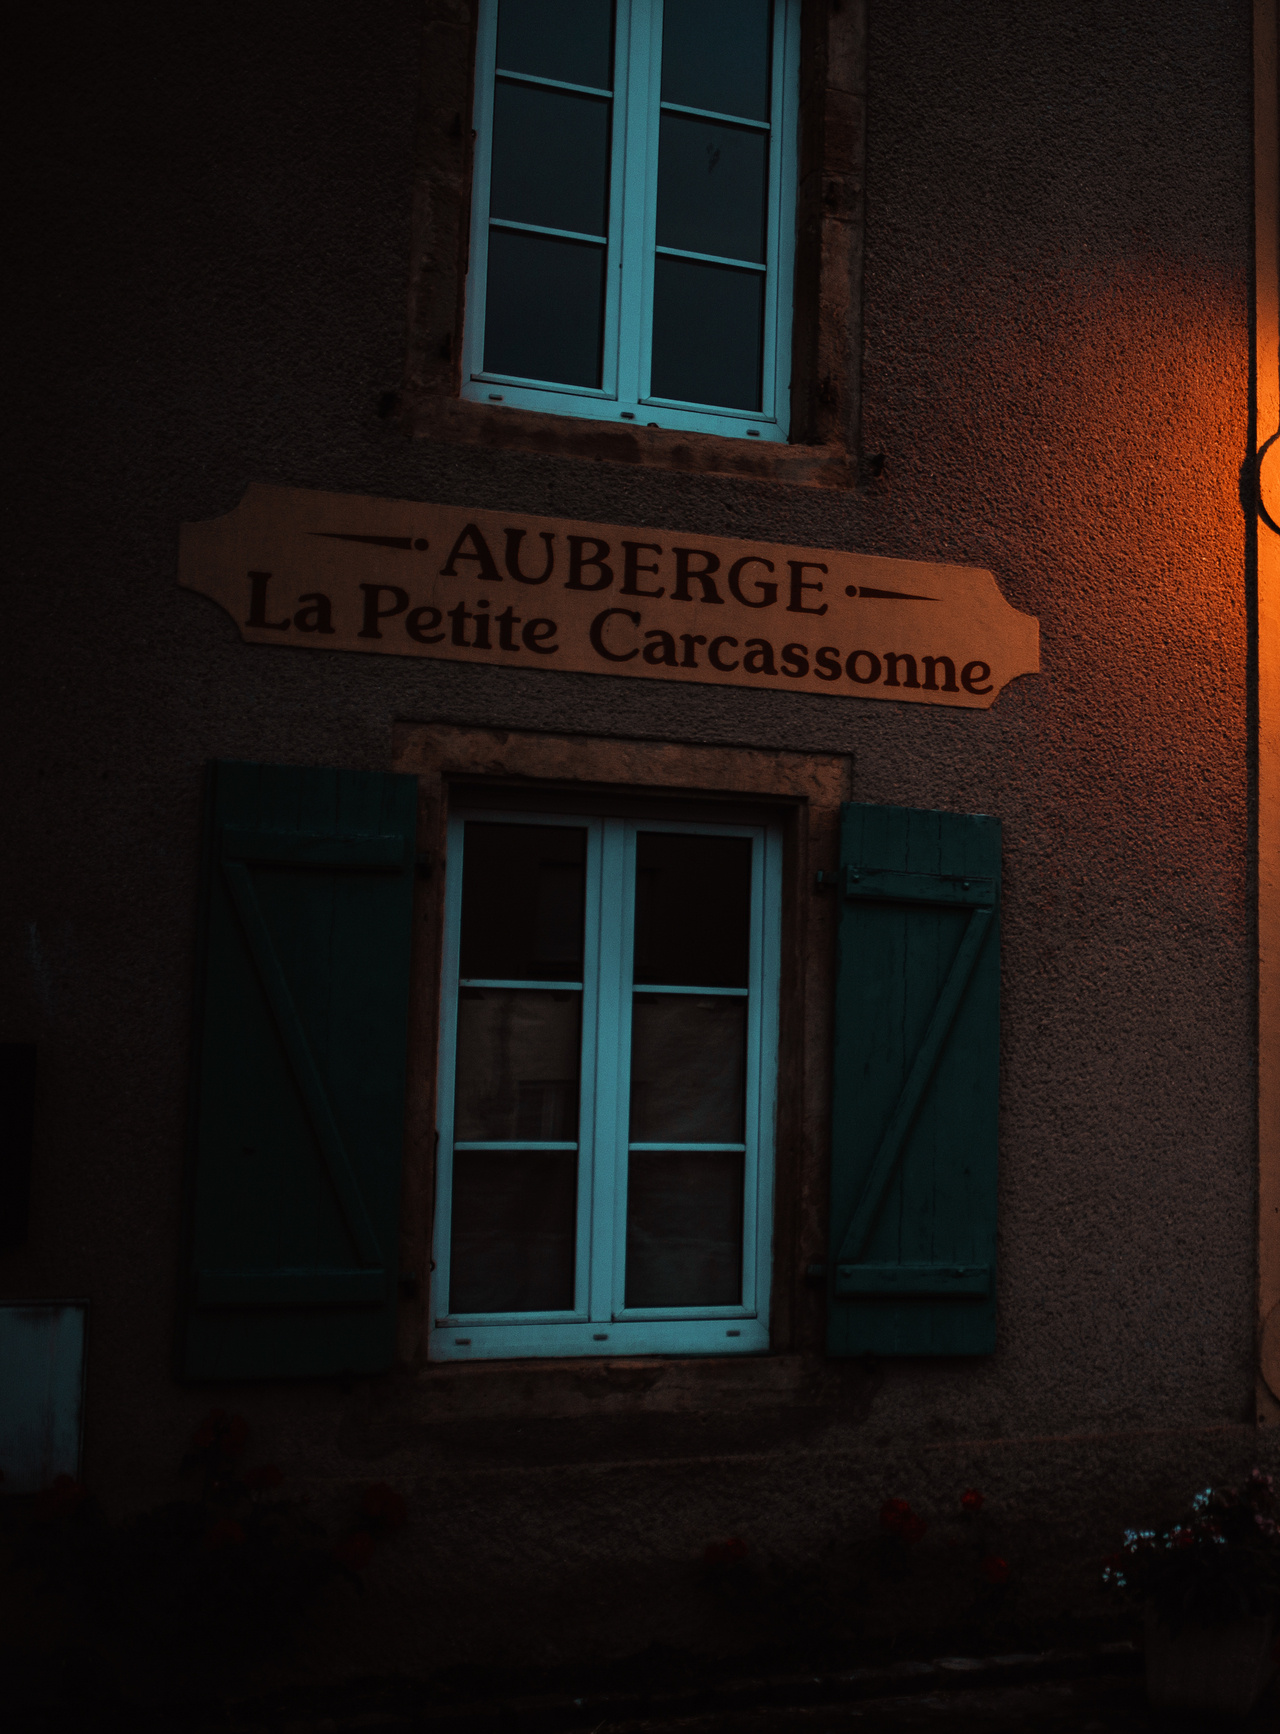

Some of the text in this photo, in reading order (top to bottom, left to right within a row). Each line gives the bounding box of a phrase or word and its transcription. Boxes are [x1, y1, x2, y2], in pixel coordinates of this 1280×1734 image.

[439, 523, 829, 616] AUBERGE
[245, 571, 995, 695] La Petite Carcassonne
